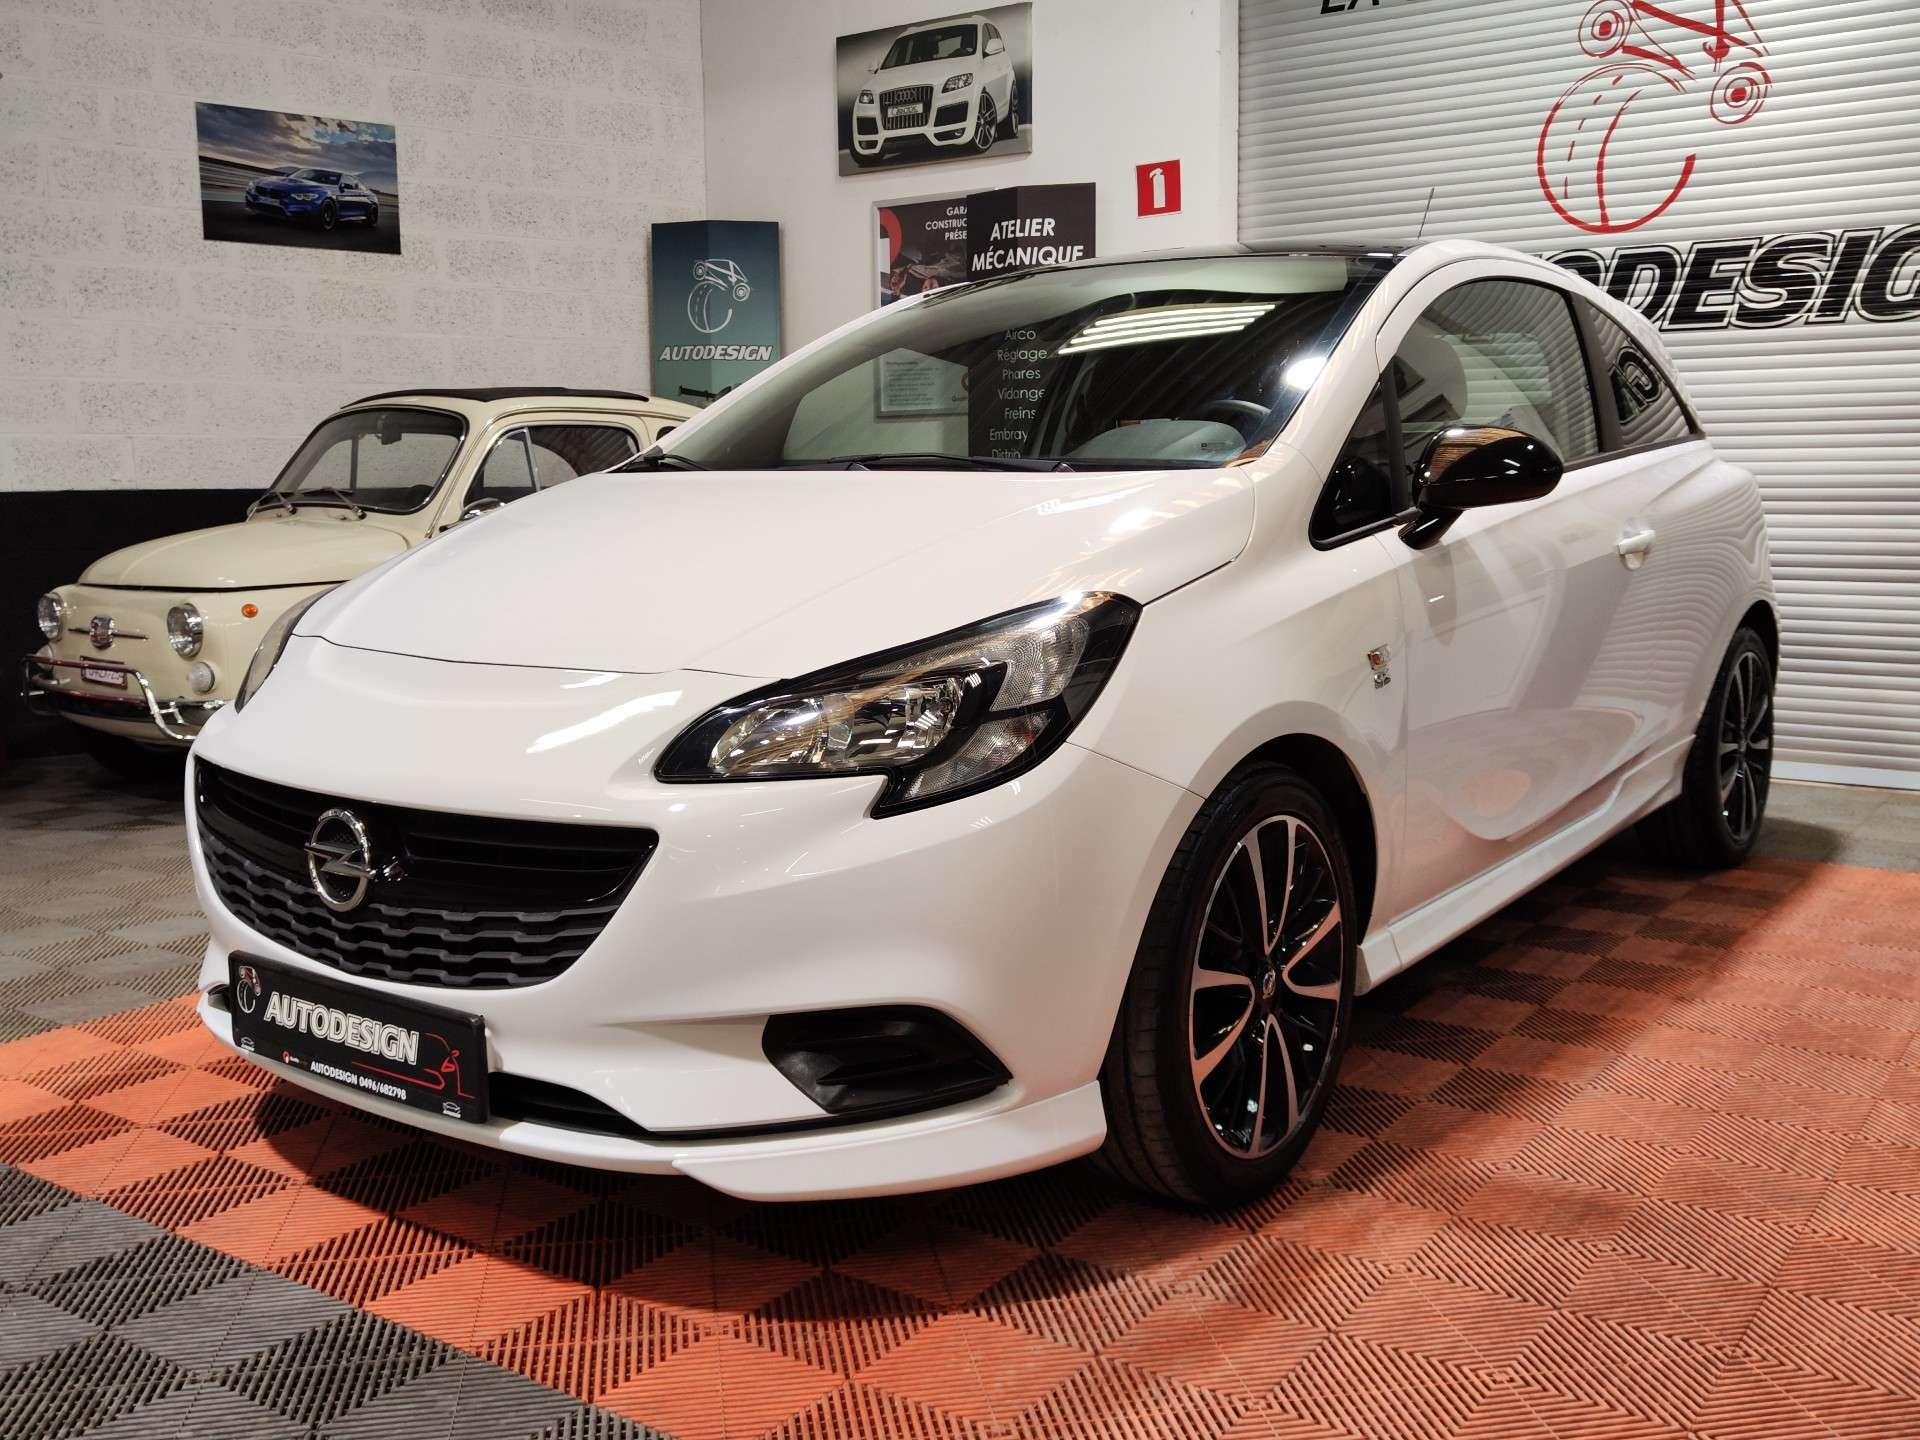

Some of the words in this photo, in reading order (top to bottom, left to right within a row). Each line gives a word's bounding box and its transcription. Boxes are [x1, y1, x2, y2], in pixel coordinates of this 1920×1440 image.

[990, 217, 1055, 241] ATELIER
[1005, 329, 1037, 341] Airco
[659, 345, 773, 361] AUTODESIGN
[997, 348, 1048, 363] Réglage
[1002, 368, 1041, 380] Phares
[1004, 406, 1037, 420] Freins
[264, 992, 419, 1064] AUTODESIGN
[310, 1061, 357, 1085] AUTODESIGN
